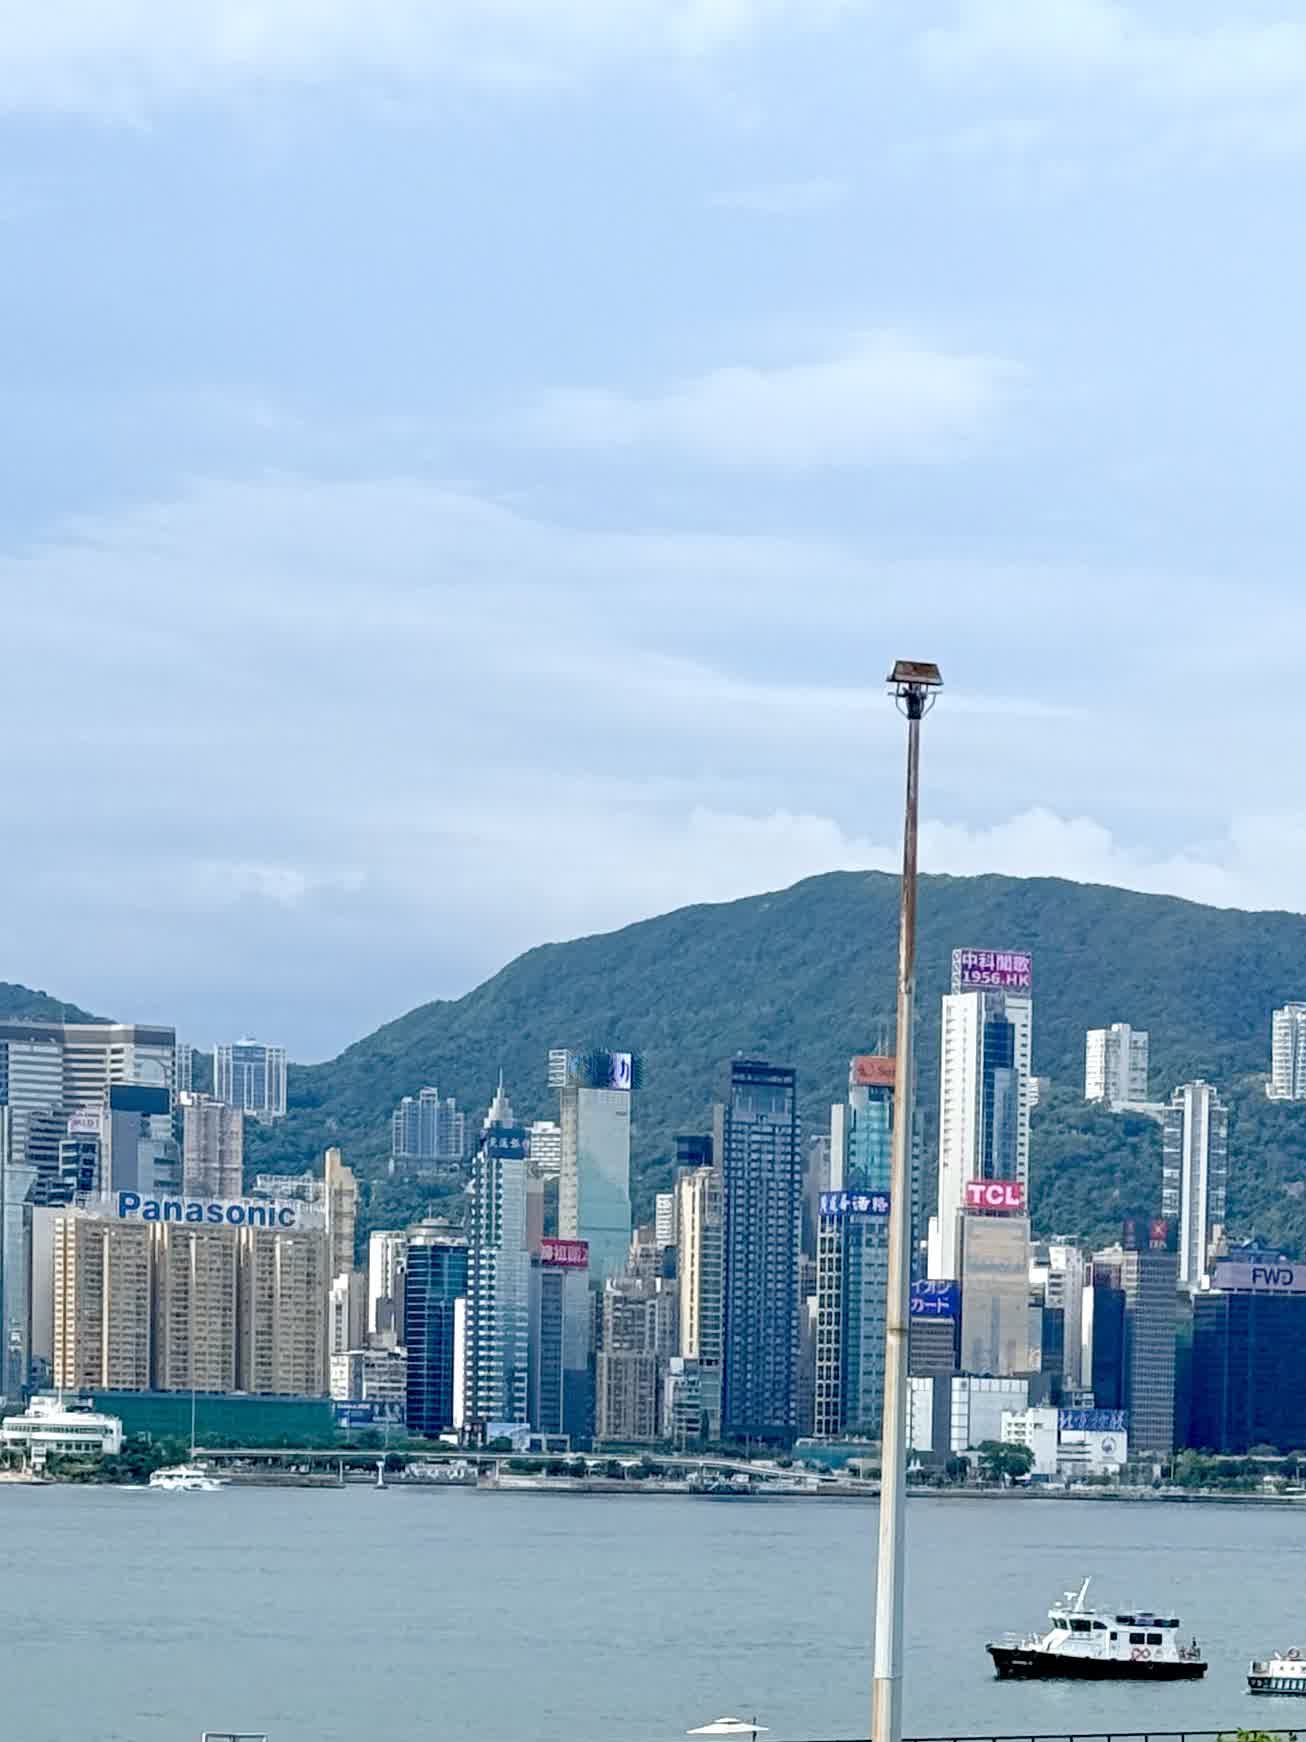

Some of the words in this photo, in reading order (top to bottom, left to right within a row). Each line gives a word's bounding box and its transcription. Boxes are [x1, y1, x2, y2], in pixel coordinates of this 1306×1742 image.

[967, 1184, 1020, 1205] TCL
[118, 1191, 296, 1227] Panasonic
[1252, 1267, 1294, 1286] FWD
